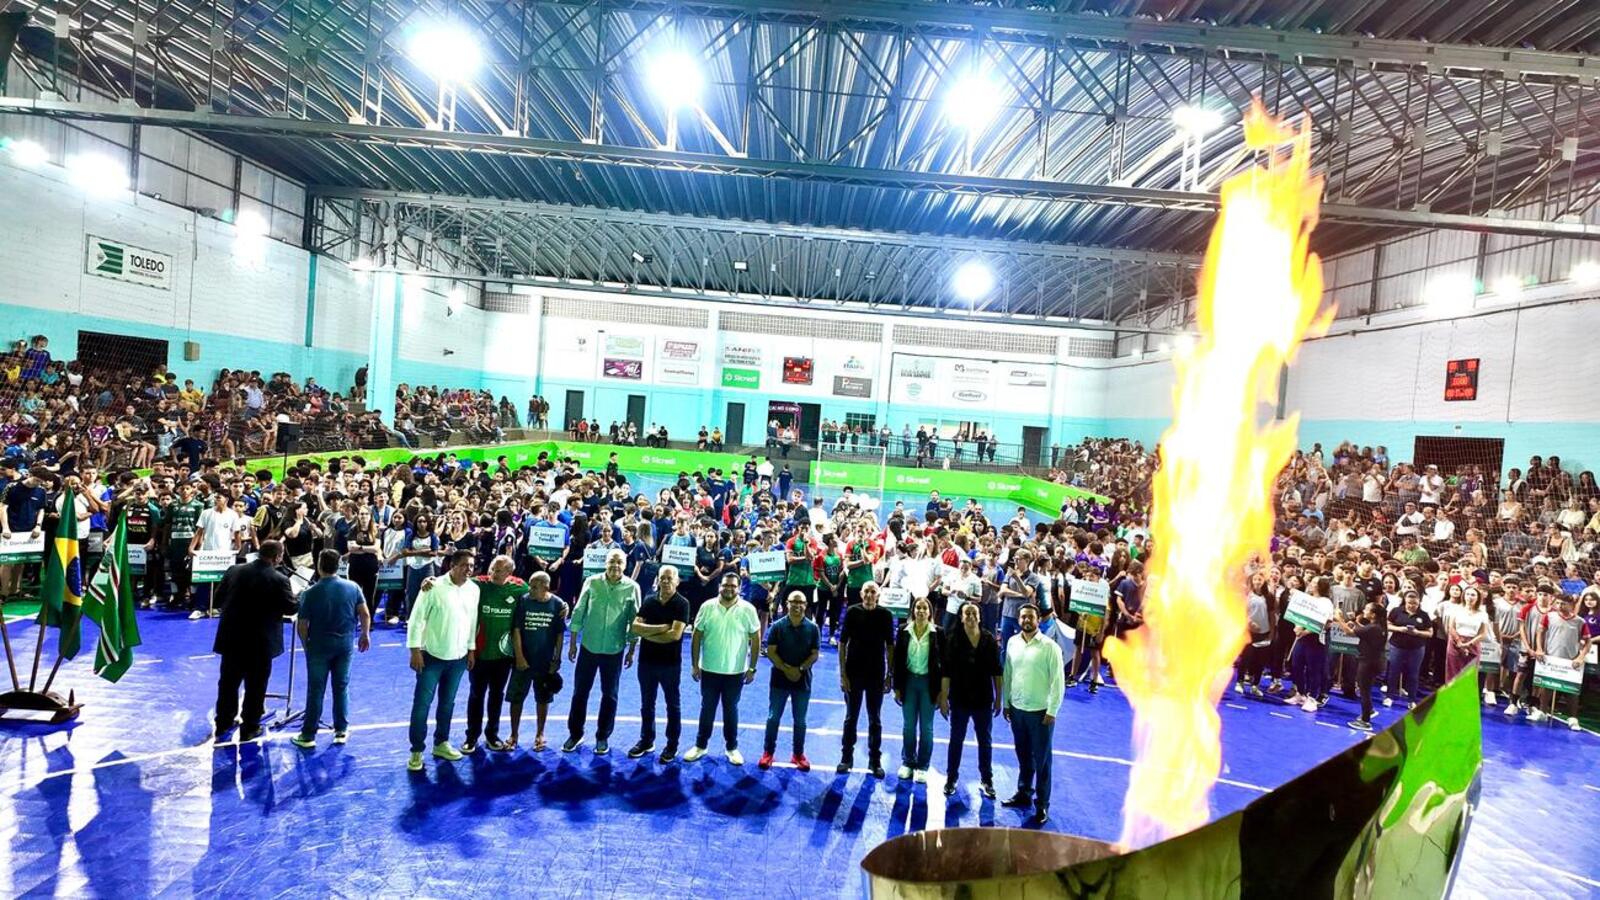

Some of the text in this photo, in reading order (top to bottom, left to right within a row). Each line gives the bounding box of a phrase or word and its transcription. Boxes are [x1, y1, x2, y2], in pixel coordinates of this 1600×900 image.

[130, 254, 165, 273] TOLEDO
[734, 374, 757, 382] Sicredi
[651, 455, 676, 465] Sicredi
[905, 475, 930, 485] Sicredi
